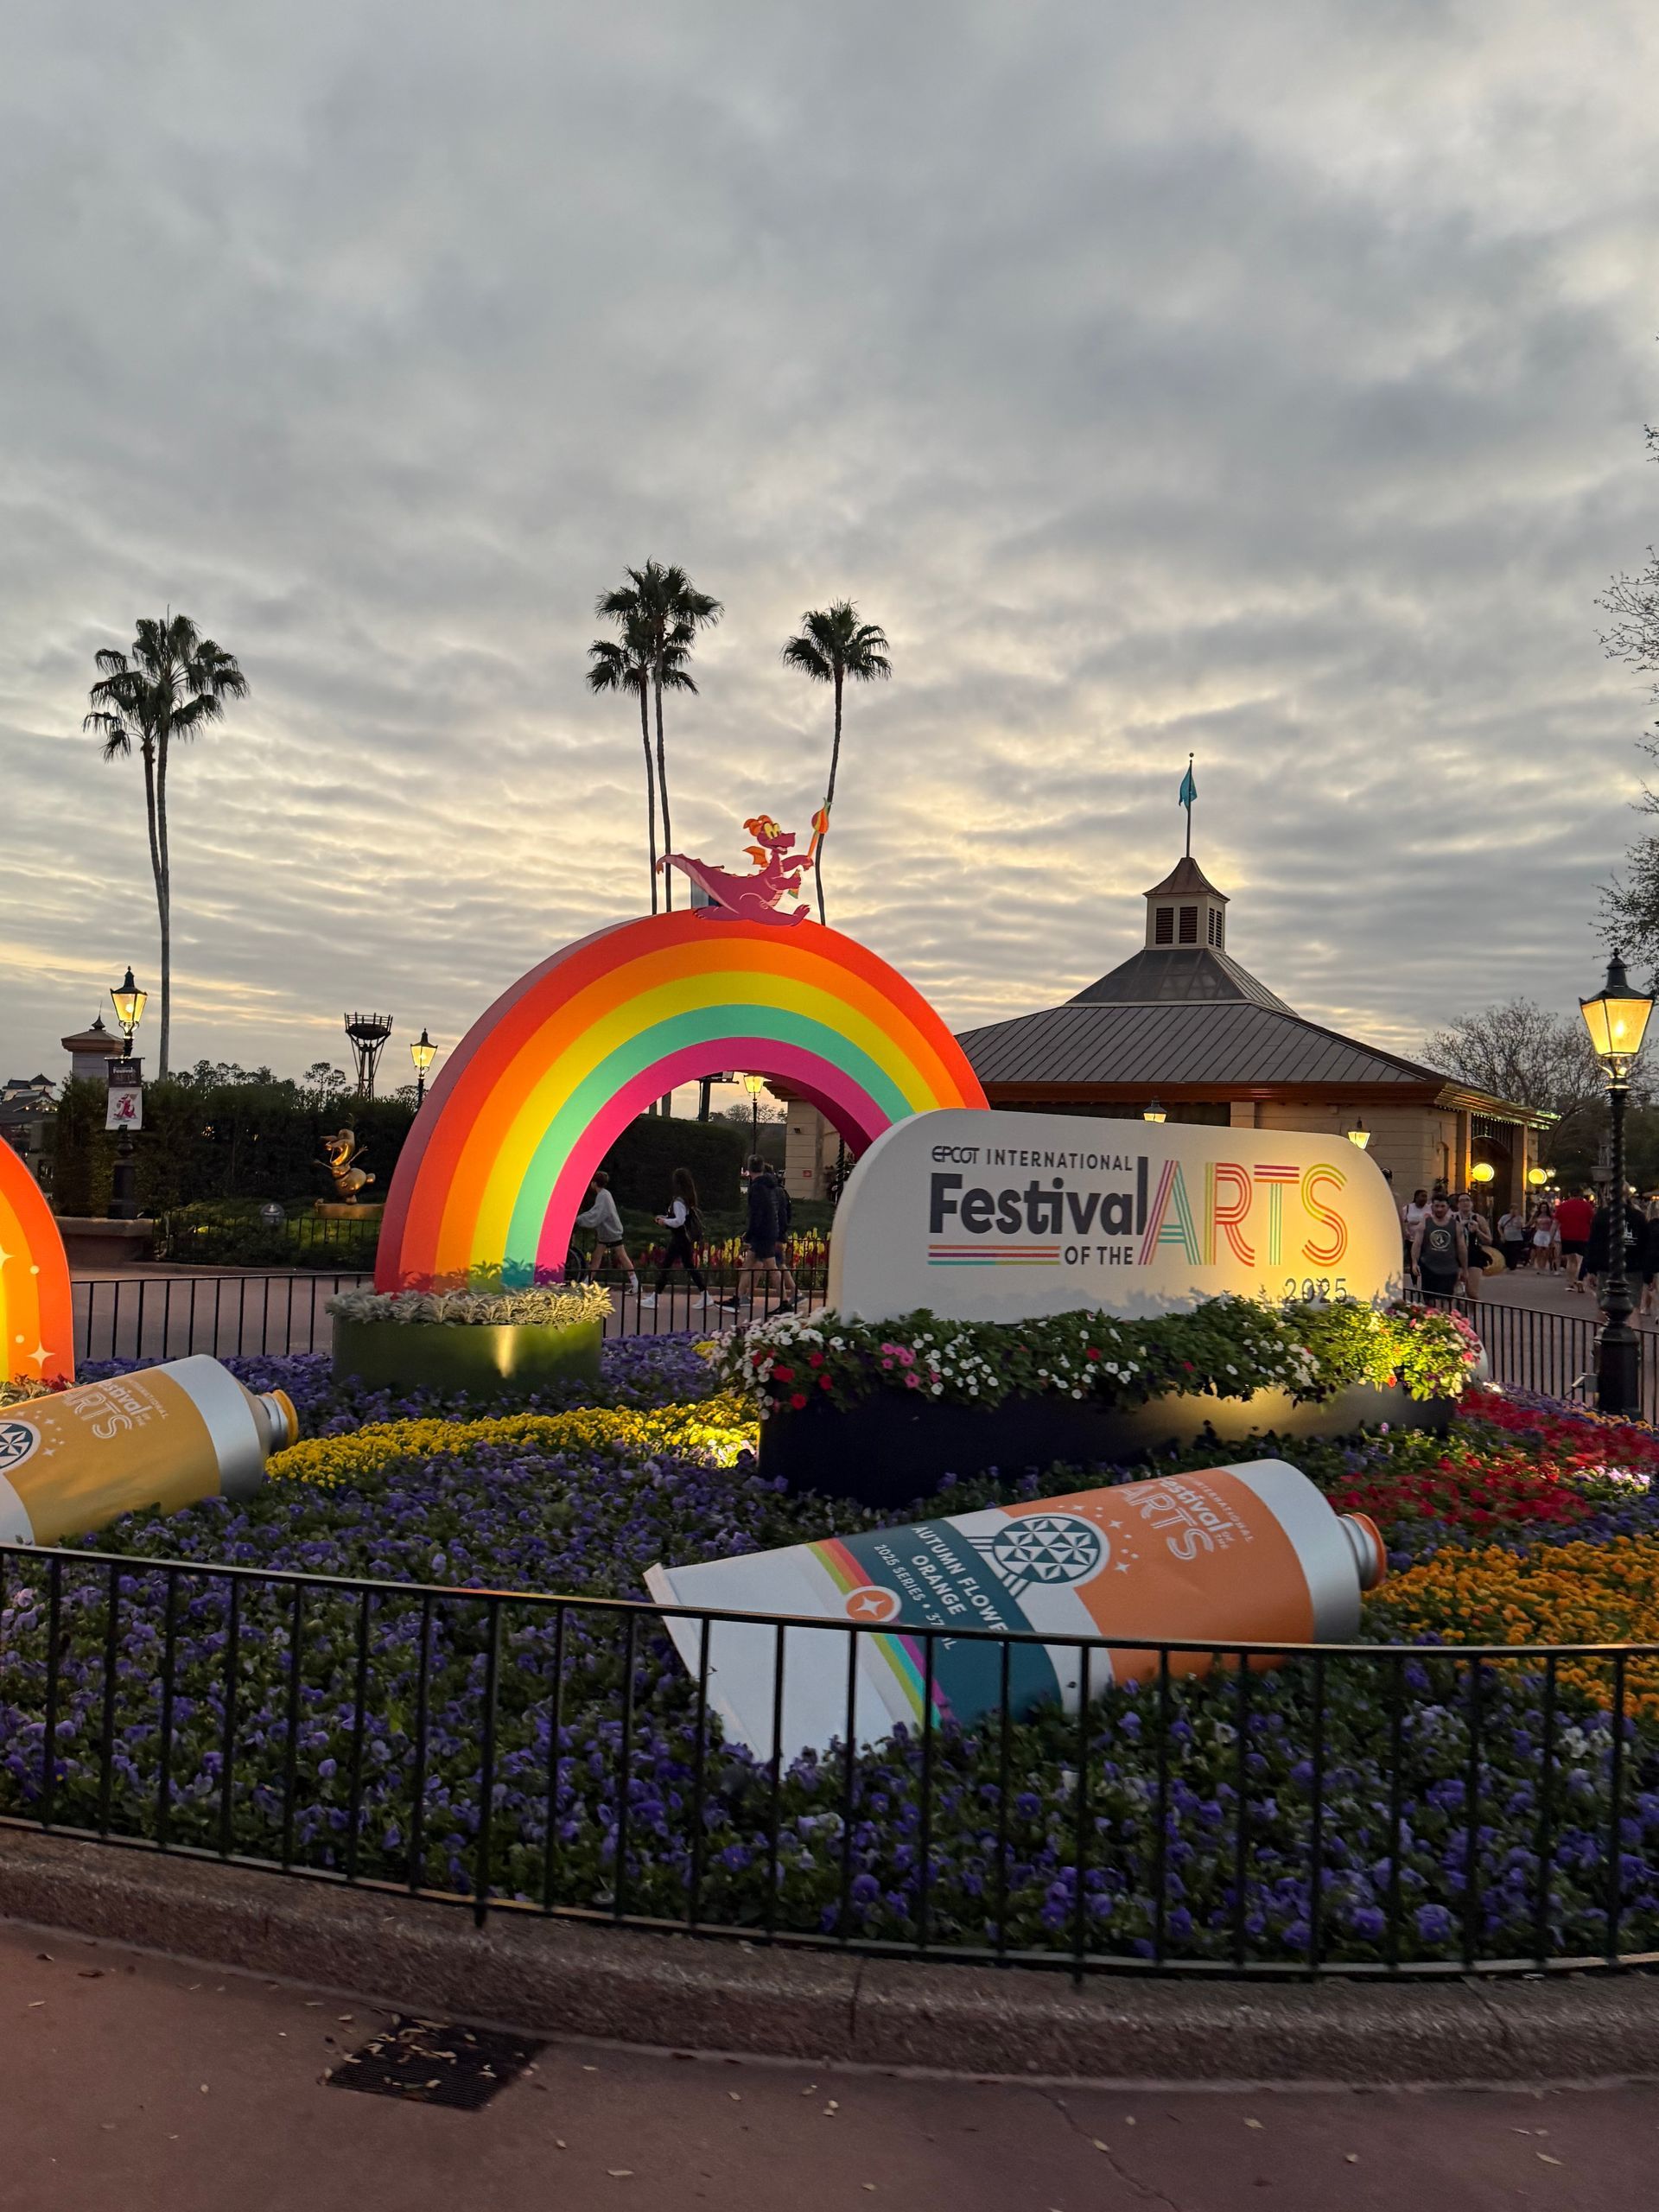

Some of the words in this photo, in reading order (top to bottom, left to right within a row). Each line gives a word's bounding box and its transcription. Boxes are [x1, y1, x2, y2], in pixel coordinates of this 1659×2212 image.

[931, 1145, 980, 1164] EPCOT
[986, 1148, 1134, 1171] INTERNATIONAL
[929, 1155, 1148, 1236] Festival
[1137, 1160, 1349, 1268] ARTS
[1065, 1245, 1090, 1265] OF
[1096, 1246, 1134, 1265] THE
[1284, 1277, 1347, 1304] 2025
[98, 1382, 154, 1415] estival
[1159, 1477, 1233, 1532] estival
[874, 1544, 900, 1567] 2025
[893, 1567, 927, 1601] SERIES
[911, 1554, 969, 1615] ORANGE
[912, 1526, 967, 1575] AUTUMN
[957, 1577, 1013, 1647] FLOWE
